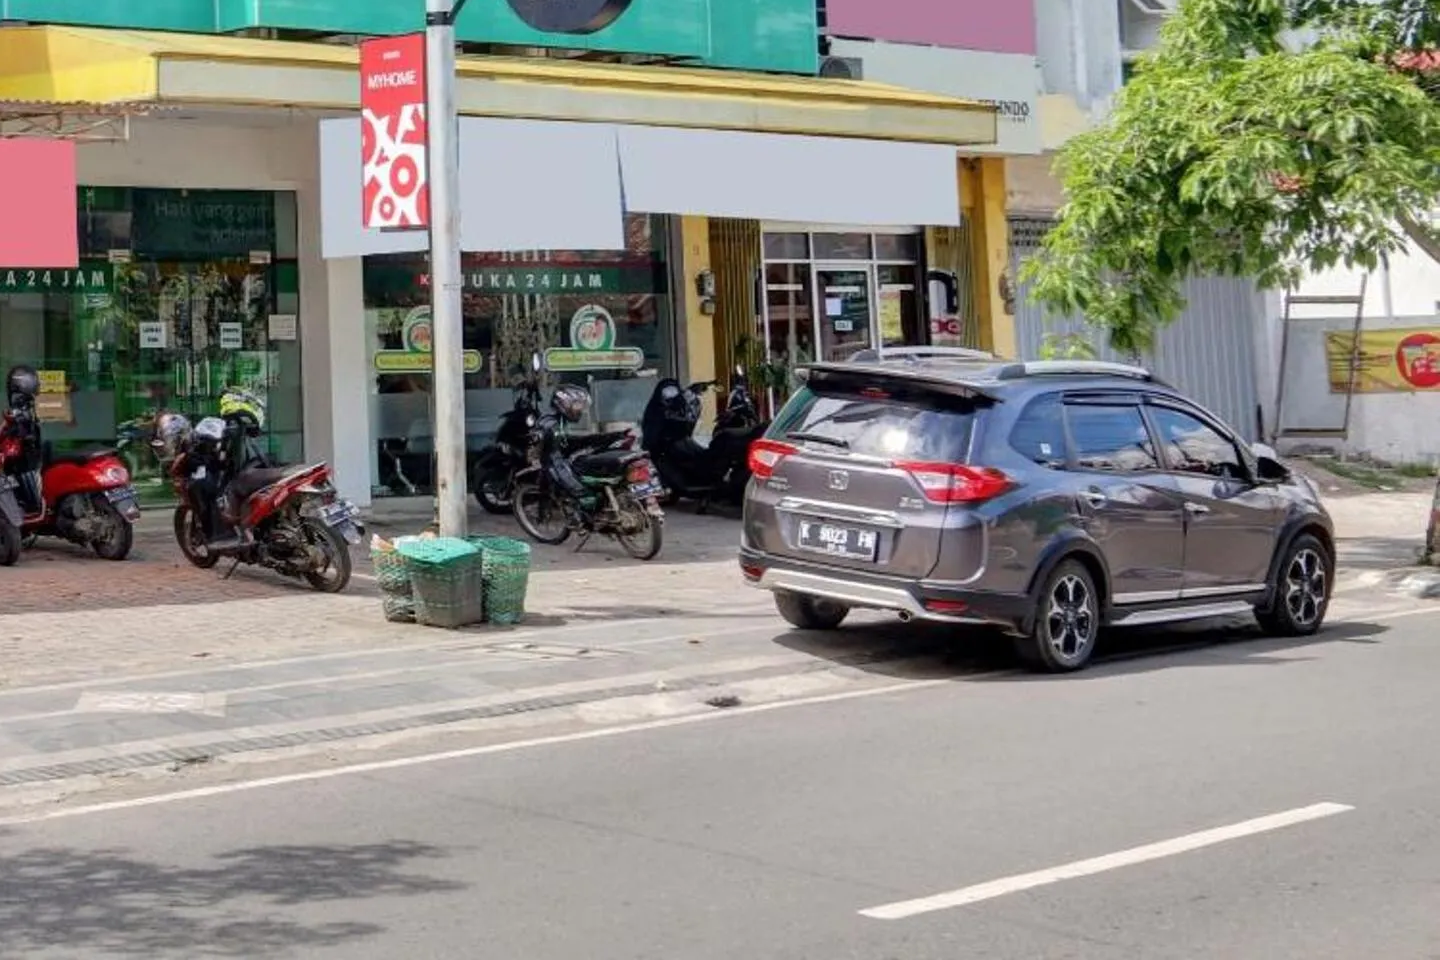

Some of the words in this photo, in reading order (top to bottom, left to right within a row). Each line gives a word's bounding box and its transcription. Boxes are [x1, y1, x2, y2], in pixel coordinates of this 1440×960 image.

[368, 69, 417, 90] MYHOME
[27, 270, 51, 287] 24
[62, 270, 105, 287] JAM
[461, 274, 516, 288] UKA
[560, 274, 602, 289] JAM
